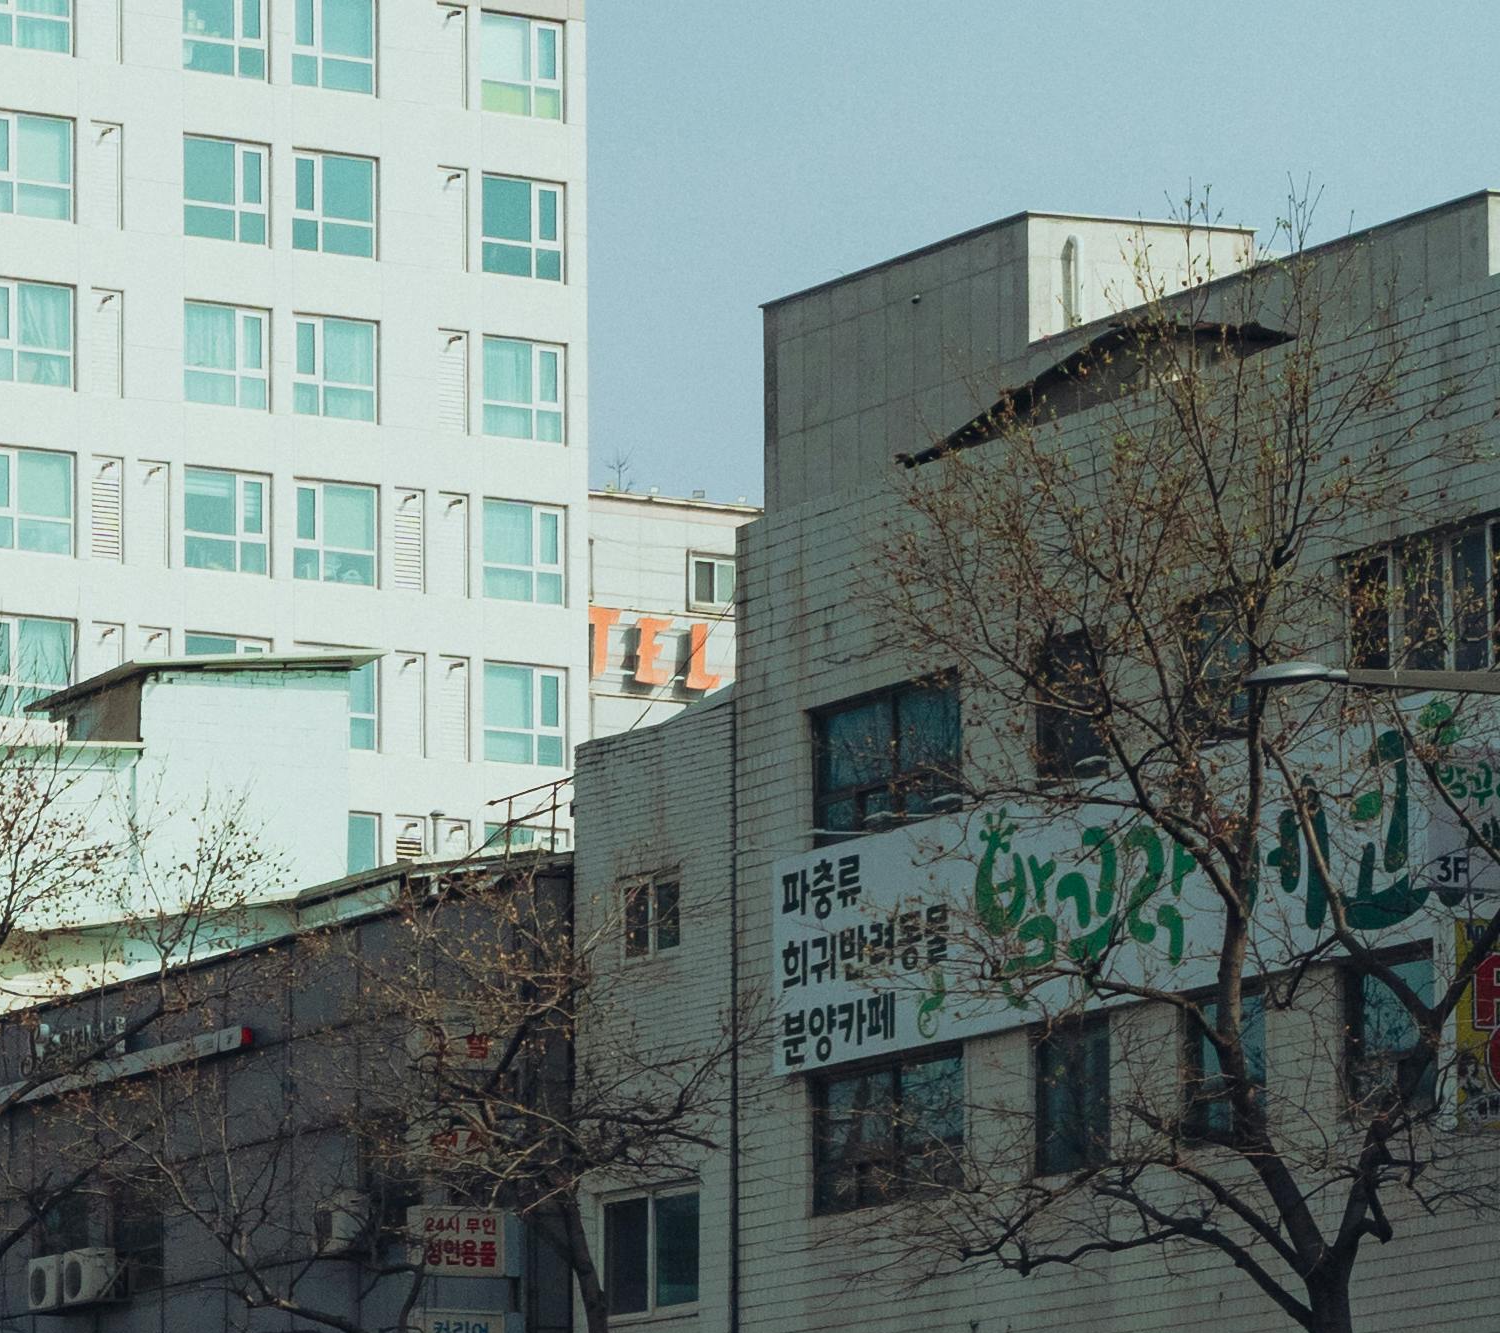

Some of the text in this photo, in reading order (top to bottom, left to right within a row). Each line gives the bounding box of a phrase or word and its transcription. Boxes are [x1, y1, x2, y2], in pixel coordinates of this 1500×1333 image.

[782, 854, 861, 919] 파충류
[1438, 855, 1468, 883] 3F
[782, 903, 950, 989] 희귀반려동물
[783, 991, 896, 1066] 분양카페
[425, 1216, 496, 1235] 24시 무인
[426, 1239, 496, 1267] 성인용품
